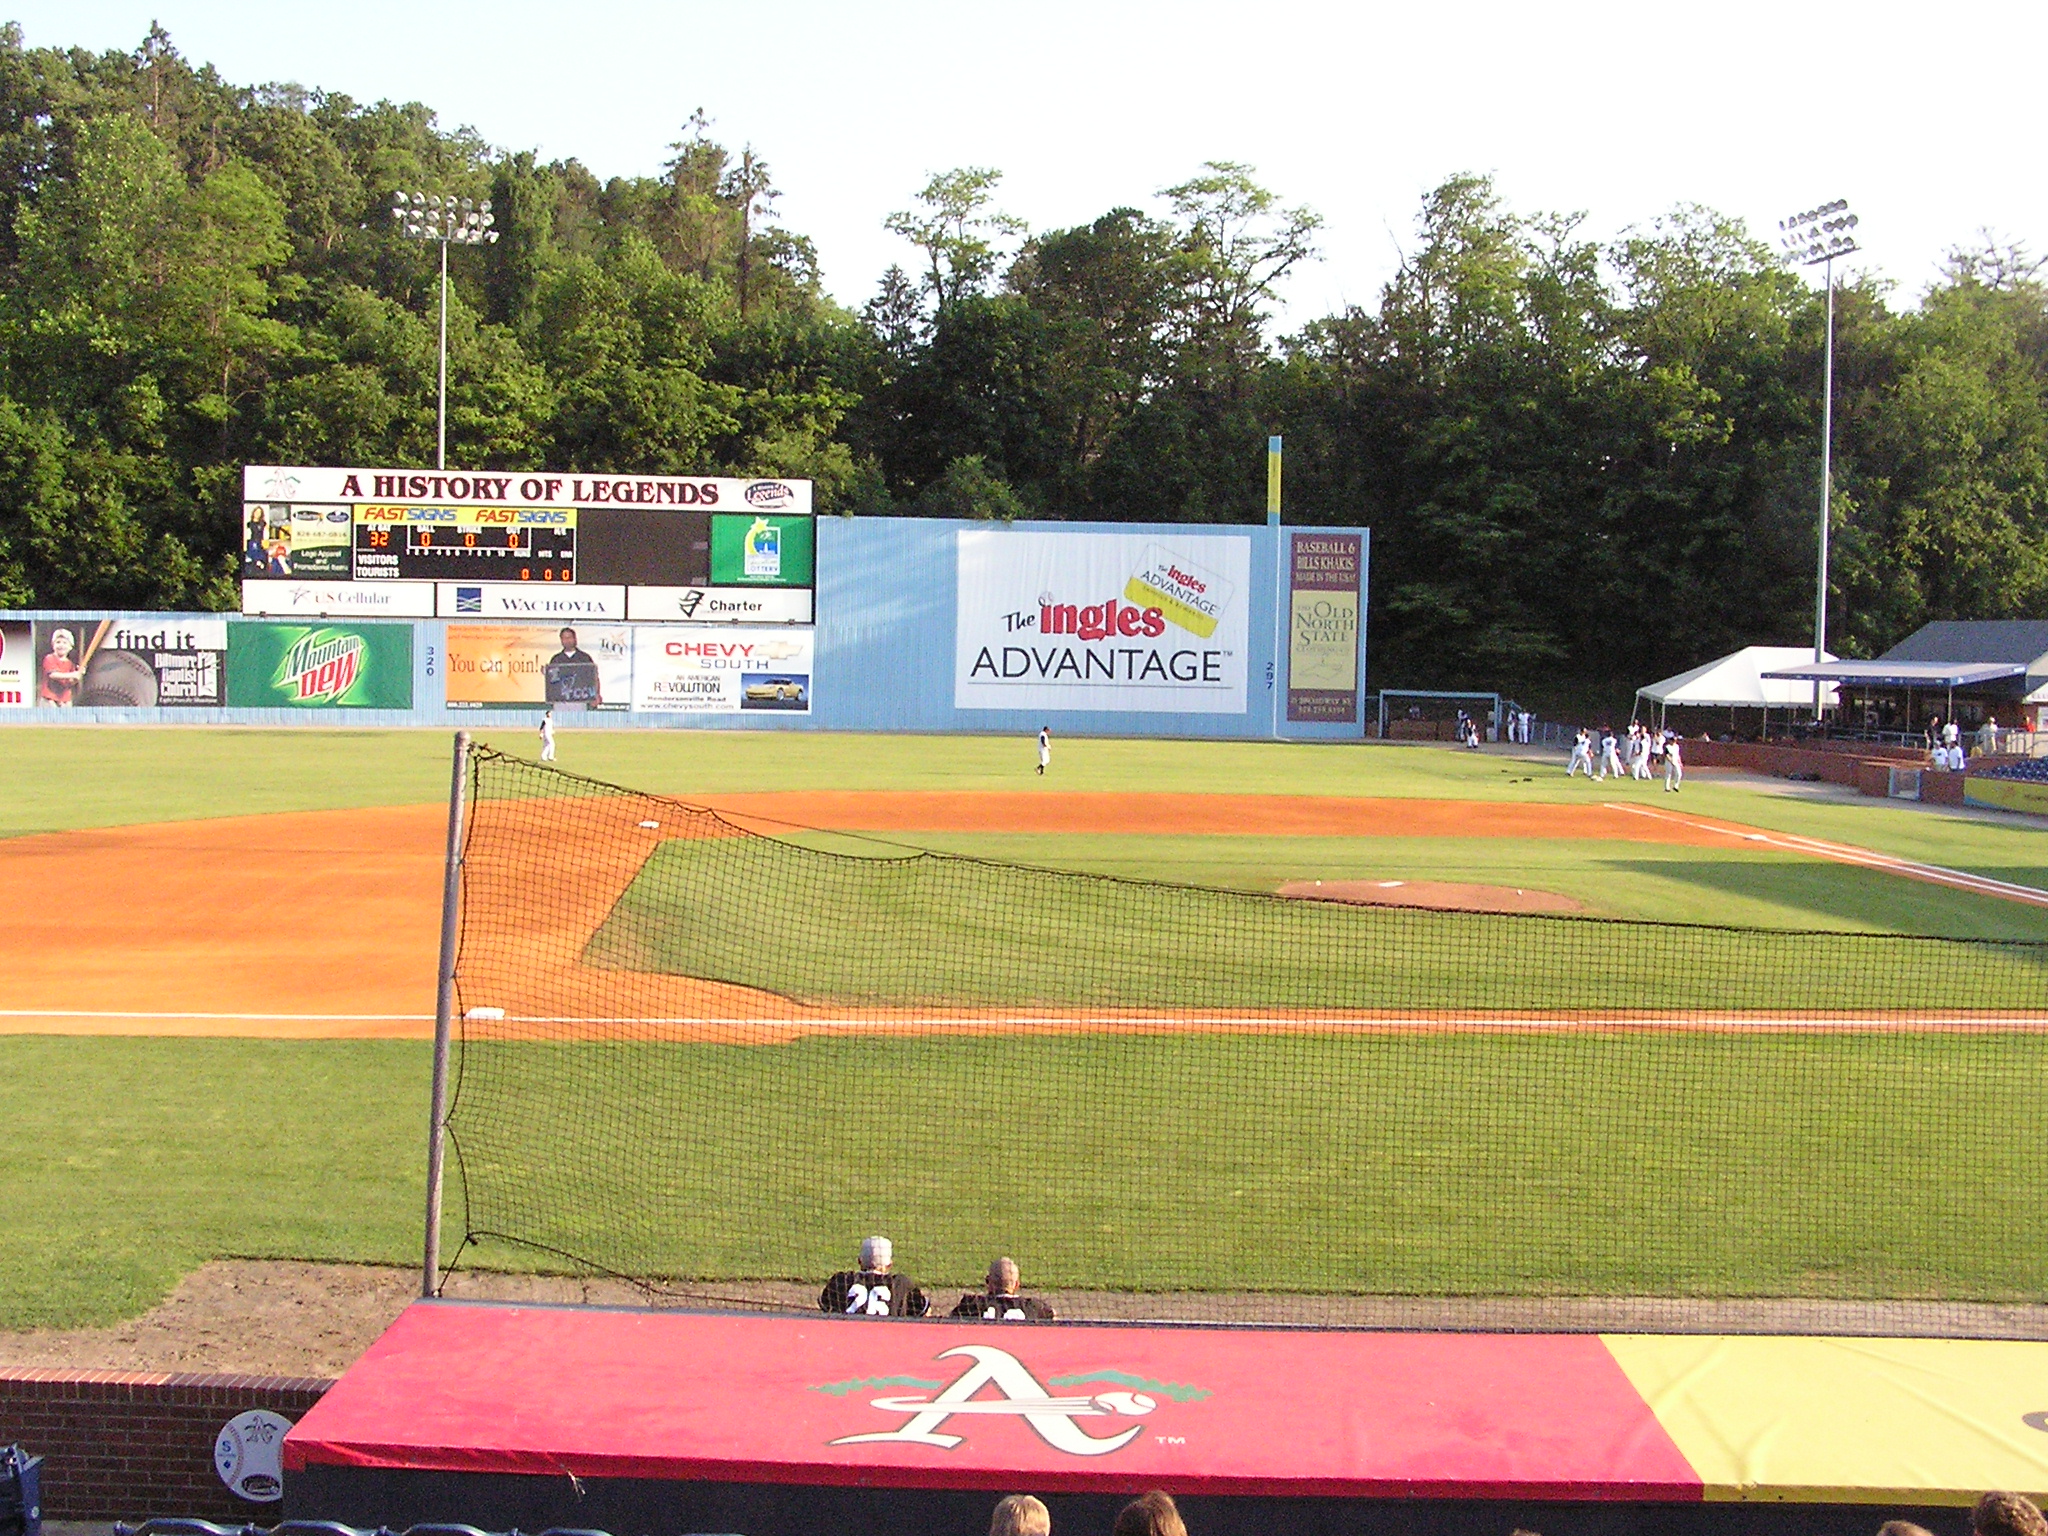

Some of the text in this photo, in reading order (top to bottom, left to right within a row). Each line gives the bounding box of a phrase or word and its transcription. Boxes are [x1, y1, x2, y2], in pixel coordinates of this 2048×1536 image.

[340, 475, 719, 505] A HISTORY OF LEGENDS
[364, 507, 457, 520] FASTSIGNS
[475, 509, 567, 523] FASTSIGNS
[370, 531, 389, 547] 32
[421, 532, 431, 547] 0
[465, 533, 475, 547] 0
[509, 533, 519, 548] 0
[1297, 541, 1346, 554] BASEBALL
[358, 555, 399, 565] VISITORS
[357, 567, 400, 577] TOURISTS
[521, 568, 530, 580] 0
[544, 569, 552, 580] 0
[562, 569, 570, 580] 0
[338, 592, 391, 604] Cellular
[1140, 570, 1217, 616] ADVANTAGE
[502, 598, 606, 612] WACHOVIA
[709, 600, 763, 611] Charter
[1314, 601, 1353, 619] OLD
[1001, 611, 1036, 633] The
[1296, 612, 1354, 630] NORTH
[115, 630, 195, 649] find it
[1300, 630, 1348, 647] STATE
[665, 642, 755, 657] CHEVY
[287, 638, 360, 680] Mountain
[449, 653, 539, 679] You can join!
[700, 659, 770, 670] SOUTH
[970, 647, 1221, 682] ADVANTAGE
[845, 1283, 892, 1316] 26
